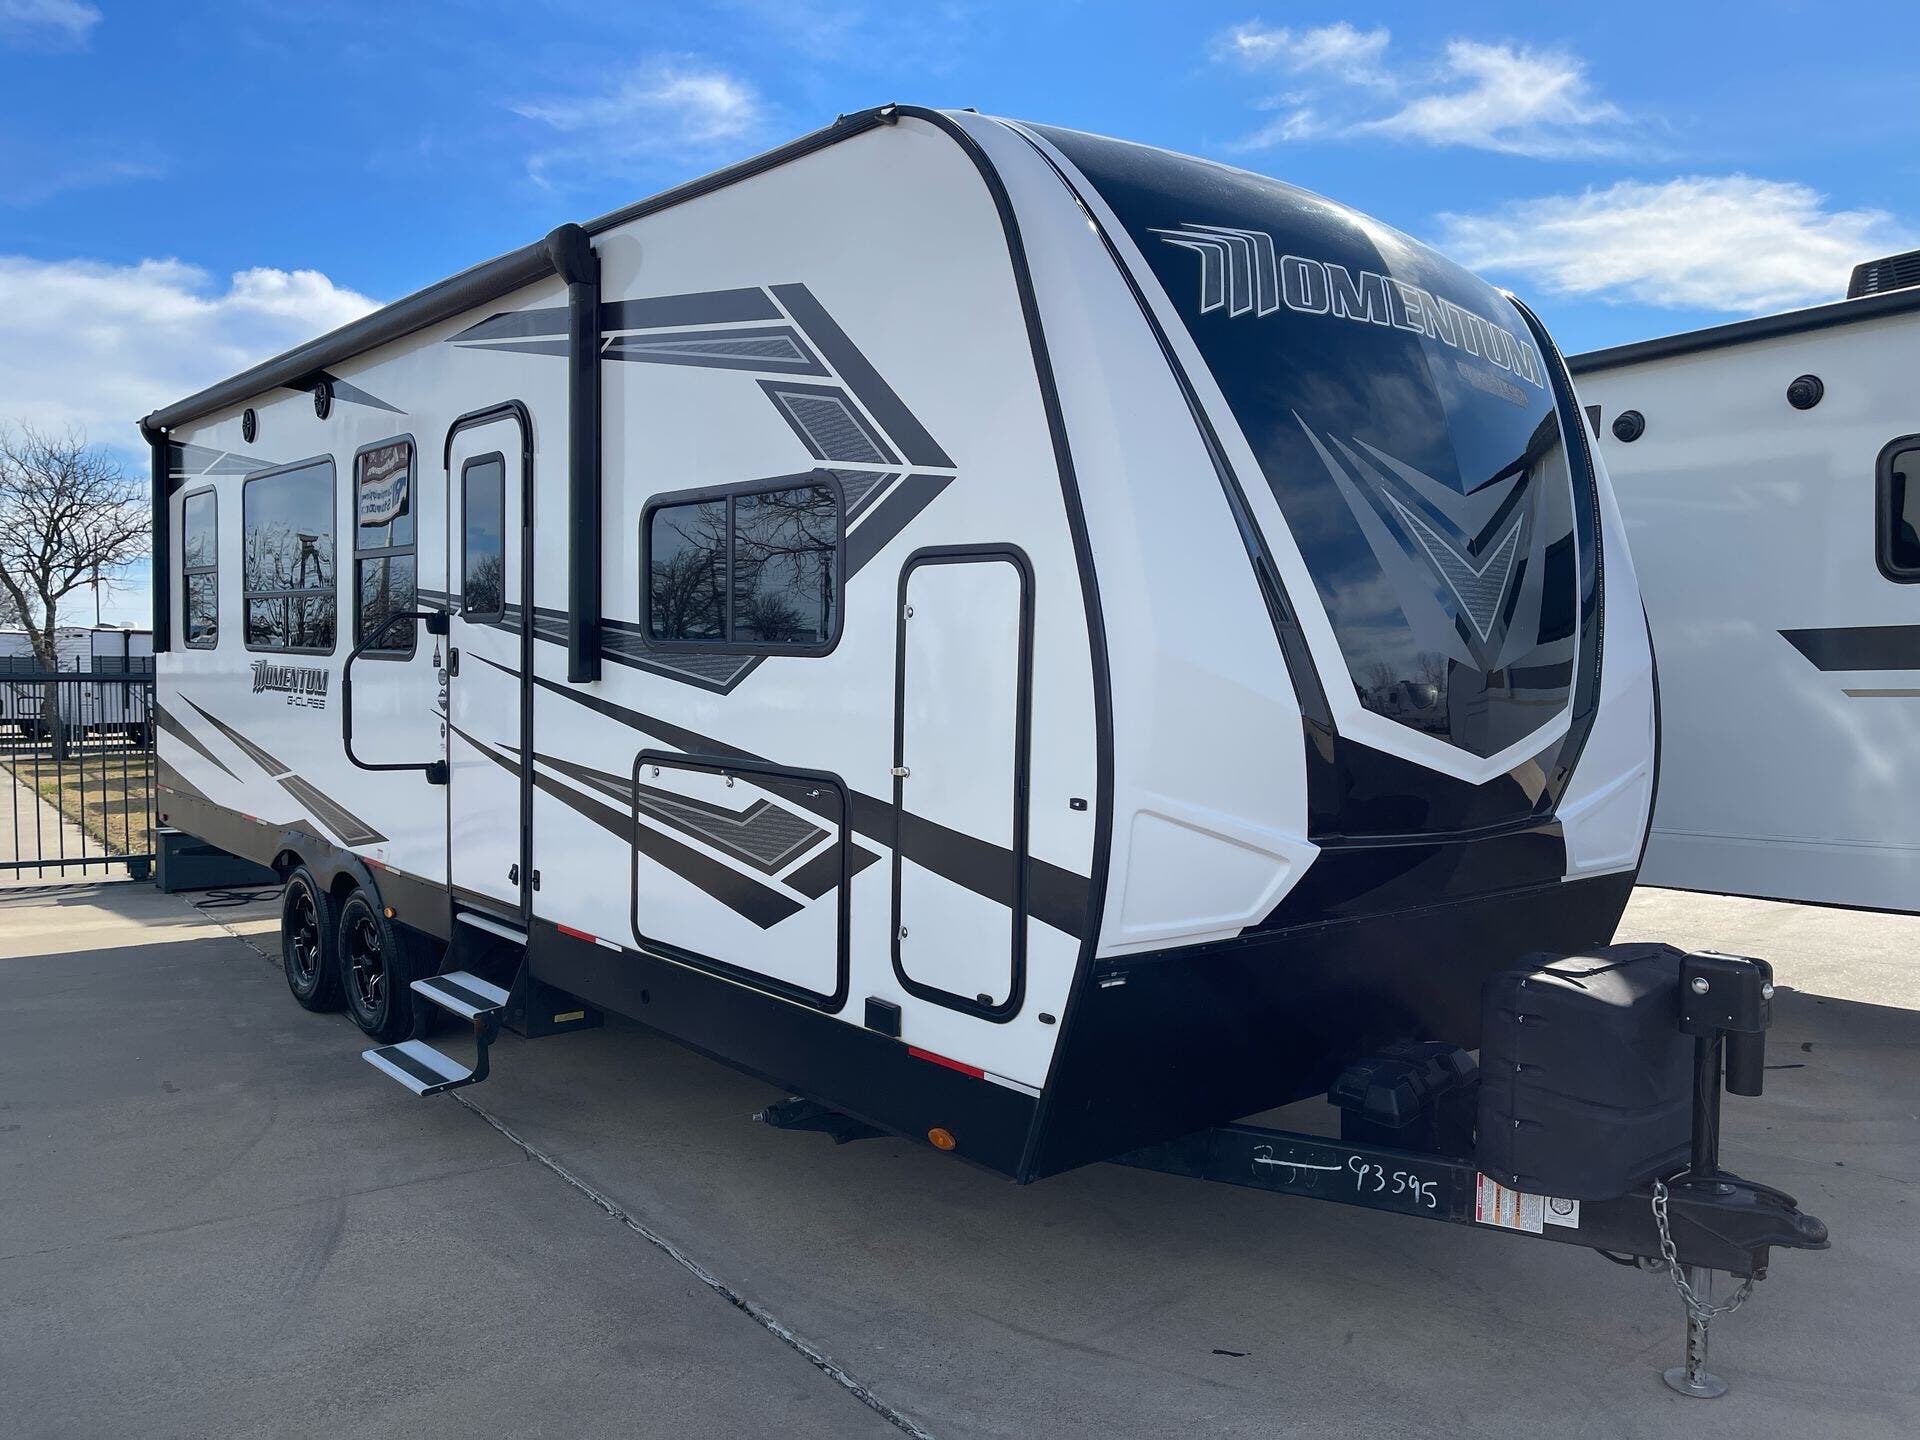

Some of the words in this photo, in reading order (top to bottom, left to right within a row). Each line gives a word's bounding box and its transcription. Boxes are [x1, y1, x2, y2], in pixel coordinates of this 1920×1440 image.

[1147, 223, 1544, 389] MOMENTUM
[250, 660, 329, 697] MOMENTUM
[286, 696, 326, 709] G-CLASS
[1349, 1155, 1438, 1208] 93595
